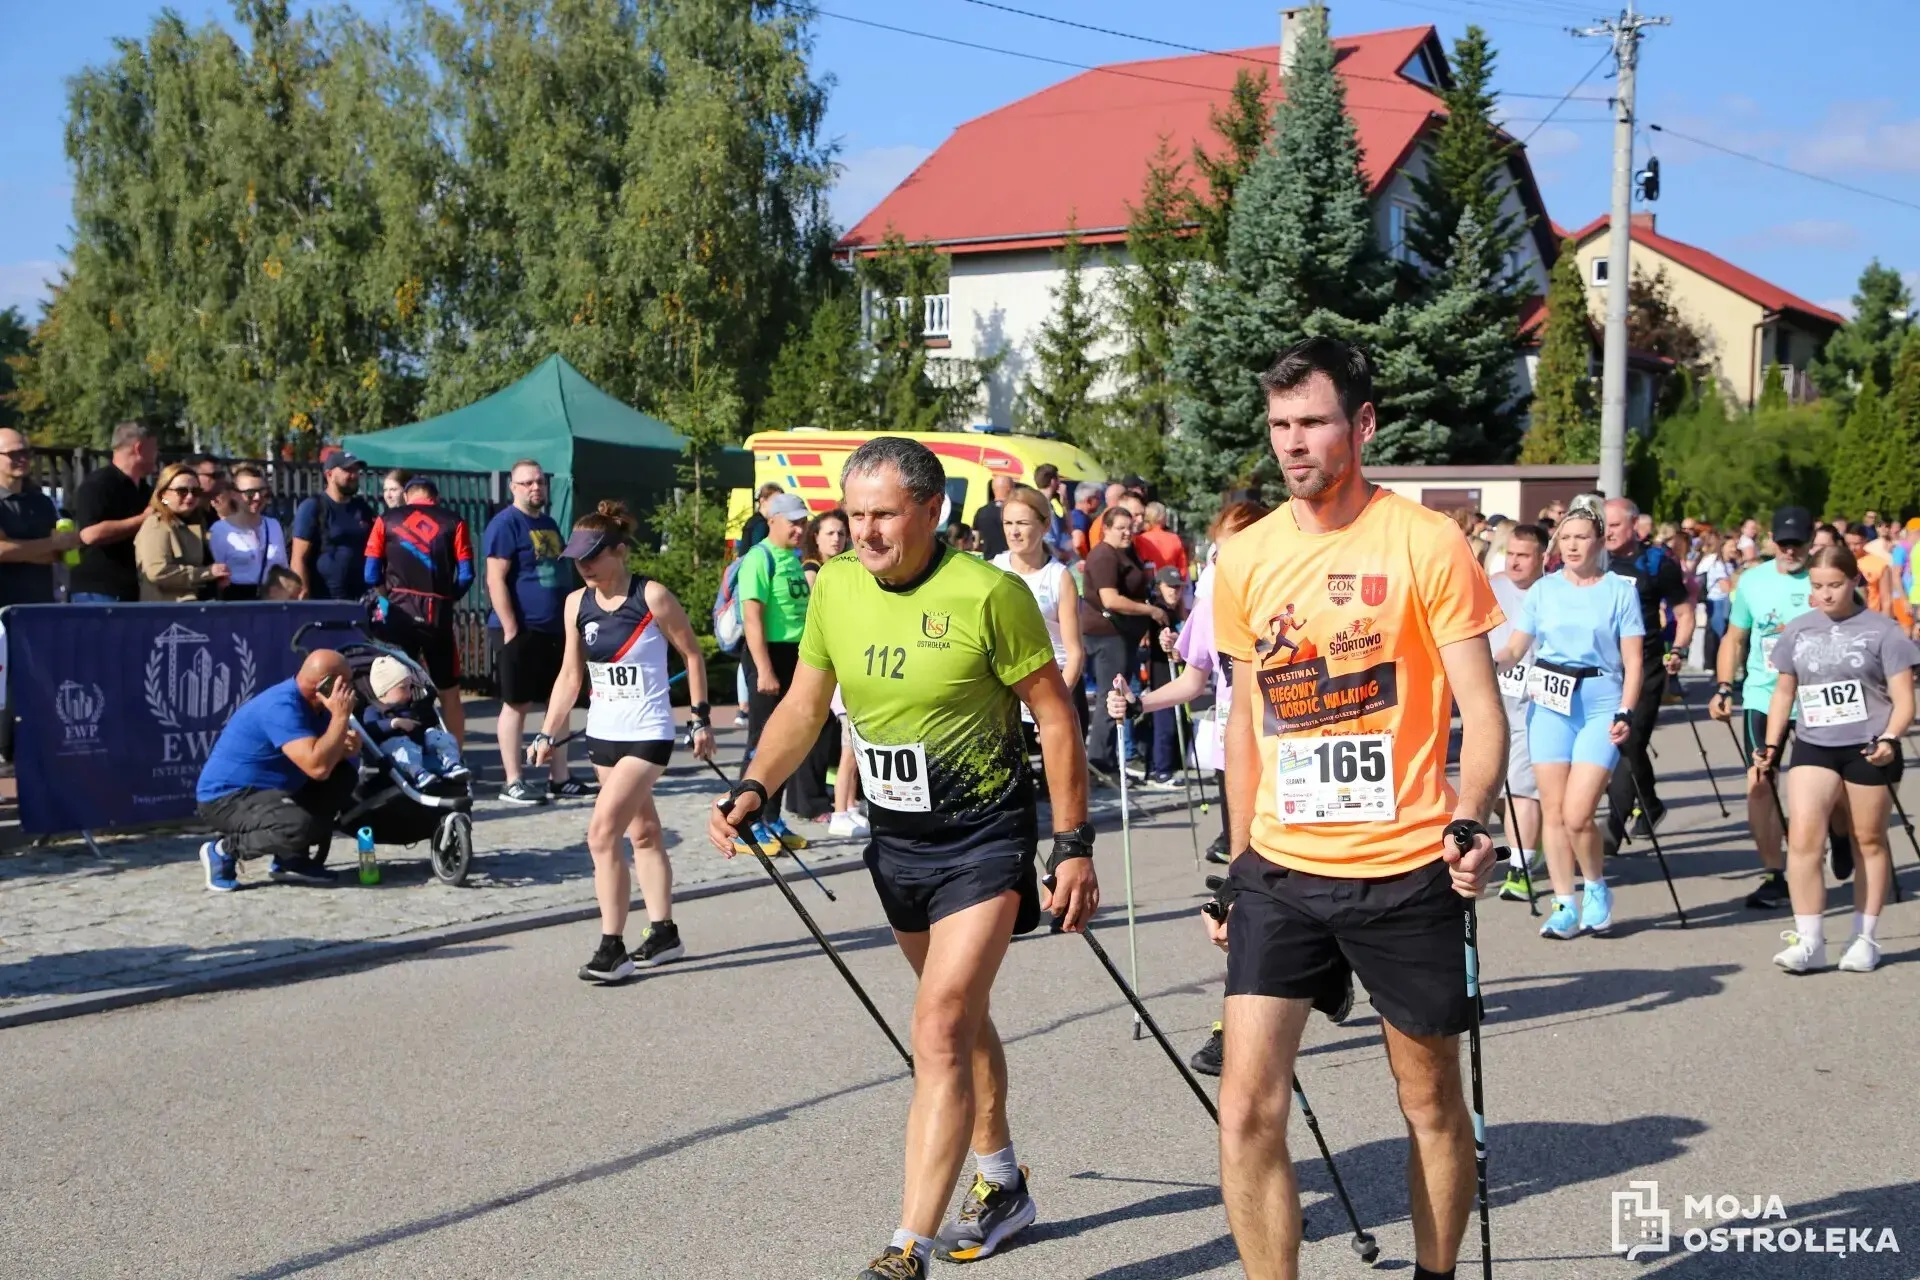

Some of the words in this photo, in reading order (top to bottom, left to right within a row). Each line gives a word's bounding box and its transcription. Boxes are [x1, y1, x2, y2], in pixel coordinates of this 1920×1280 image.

[1327, 580, 1356, 592] GOK
[927, 619, 944, 635] KS
[1335, 630, 1348, 642] NA
[917, 640, 951, 651] OSTROŁĘKA
[1329, 633, 1382, 656] SPORTOWO
[864, 644, 907, 680] 112
[607, 666, 638, 686] 187
[1265, 675, 1275, 685] III
[1276, 667, 1319, 682] FESTIWAL
[1543, 674, 1571, 698] 136
[1268, 680, 1317, 704] BIEGOWY
[1280, 696, 1321, 719] NORDIC
[1323, 680, 1379, 710] WALKING
[1820, 683, 1859, 707] 162
[65, 724, 98, 739] EWP
[161, 730, 219, 762] EW
[864, 747, 918, 782] 170
[1314, 740, 1386, 783] 165
